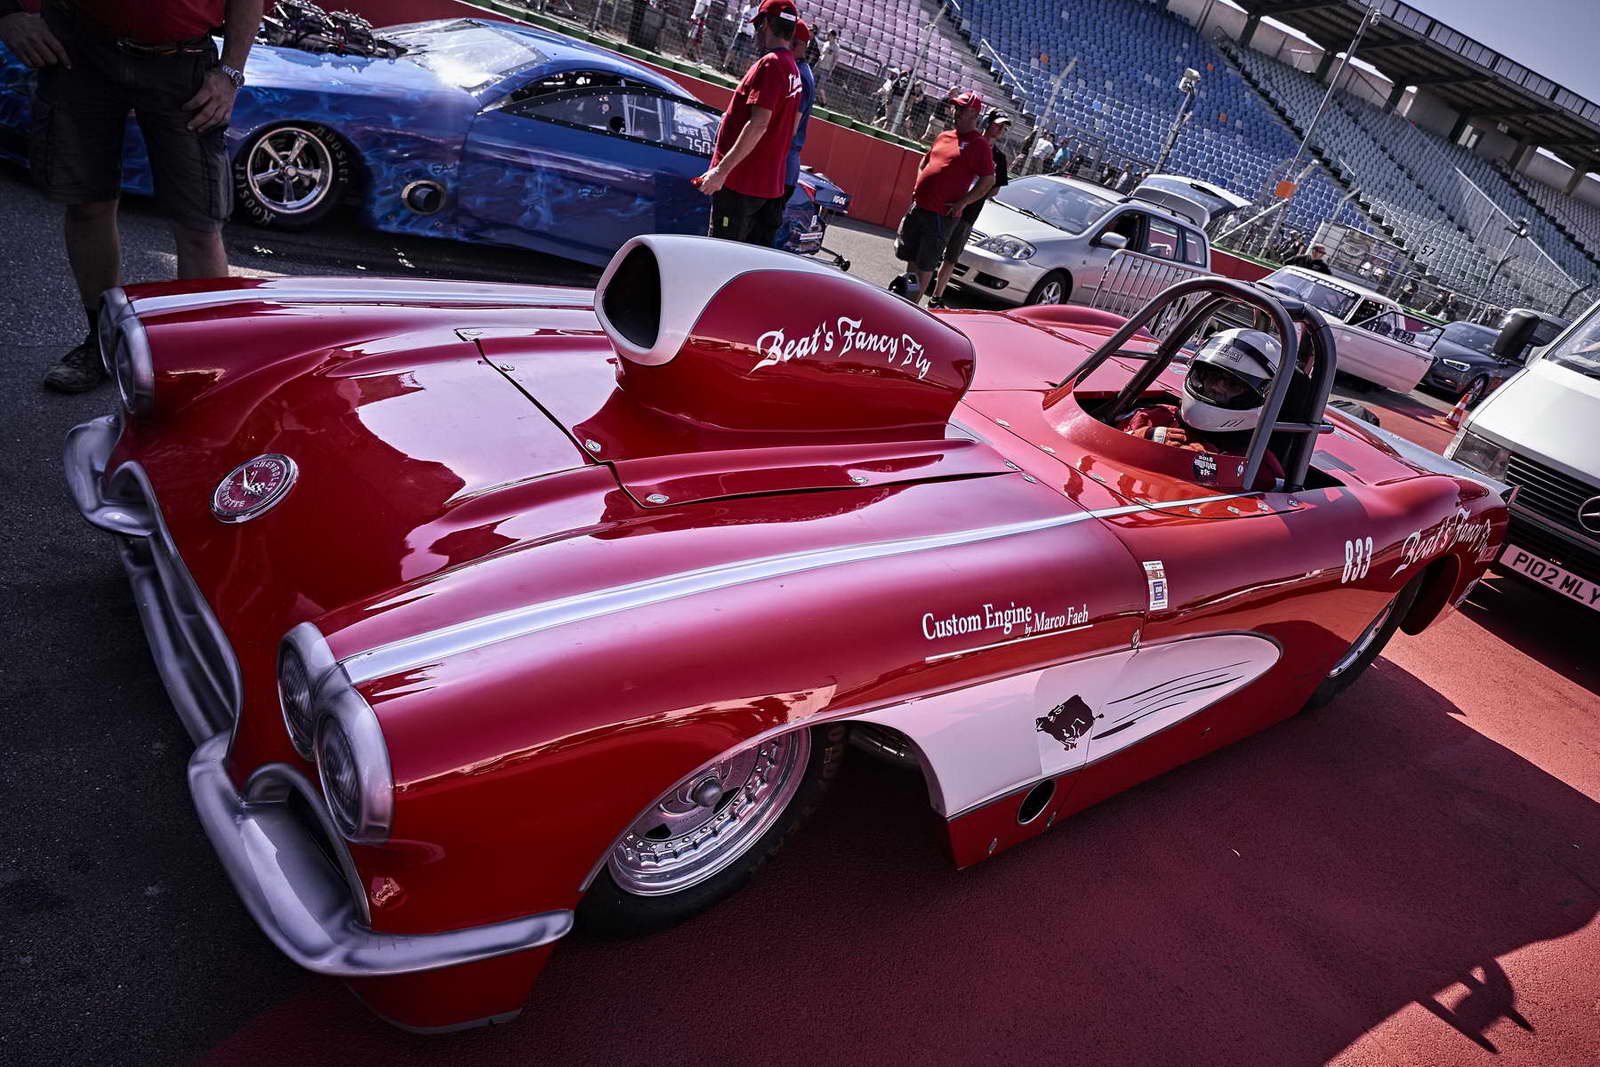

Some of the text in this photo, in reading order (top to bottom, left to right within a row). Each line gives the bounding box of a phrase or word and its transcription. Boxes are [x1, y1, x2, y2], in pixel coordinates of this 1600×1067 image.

[1421, 245, 1436, 257] 57
[748, 316, 932, 379] Beat's Fancy Fly
[1341, 536, 1373, 584] 833
[1390, 516, 1452, 580] Beat's
[1512, 552, 1600, 605] P102 MLY
[922, 601, 1033, 640] Custom Engine
[1024, 603, 1089, 637] by Marco Faeh
